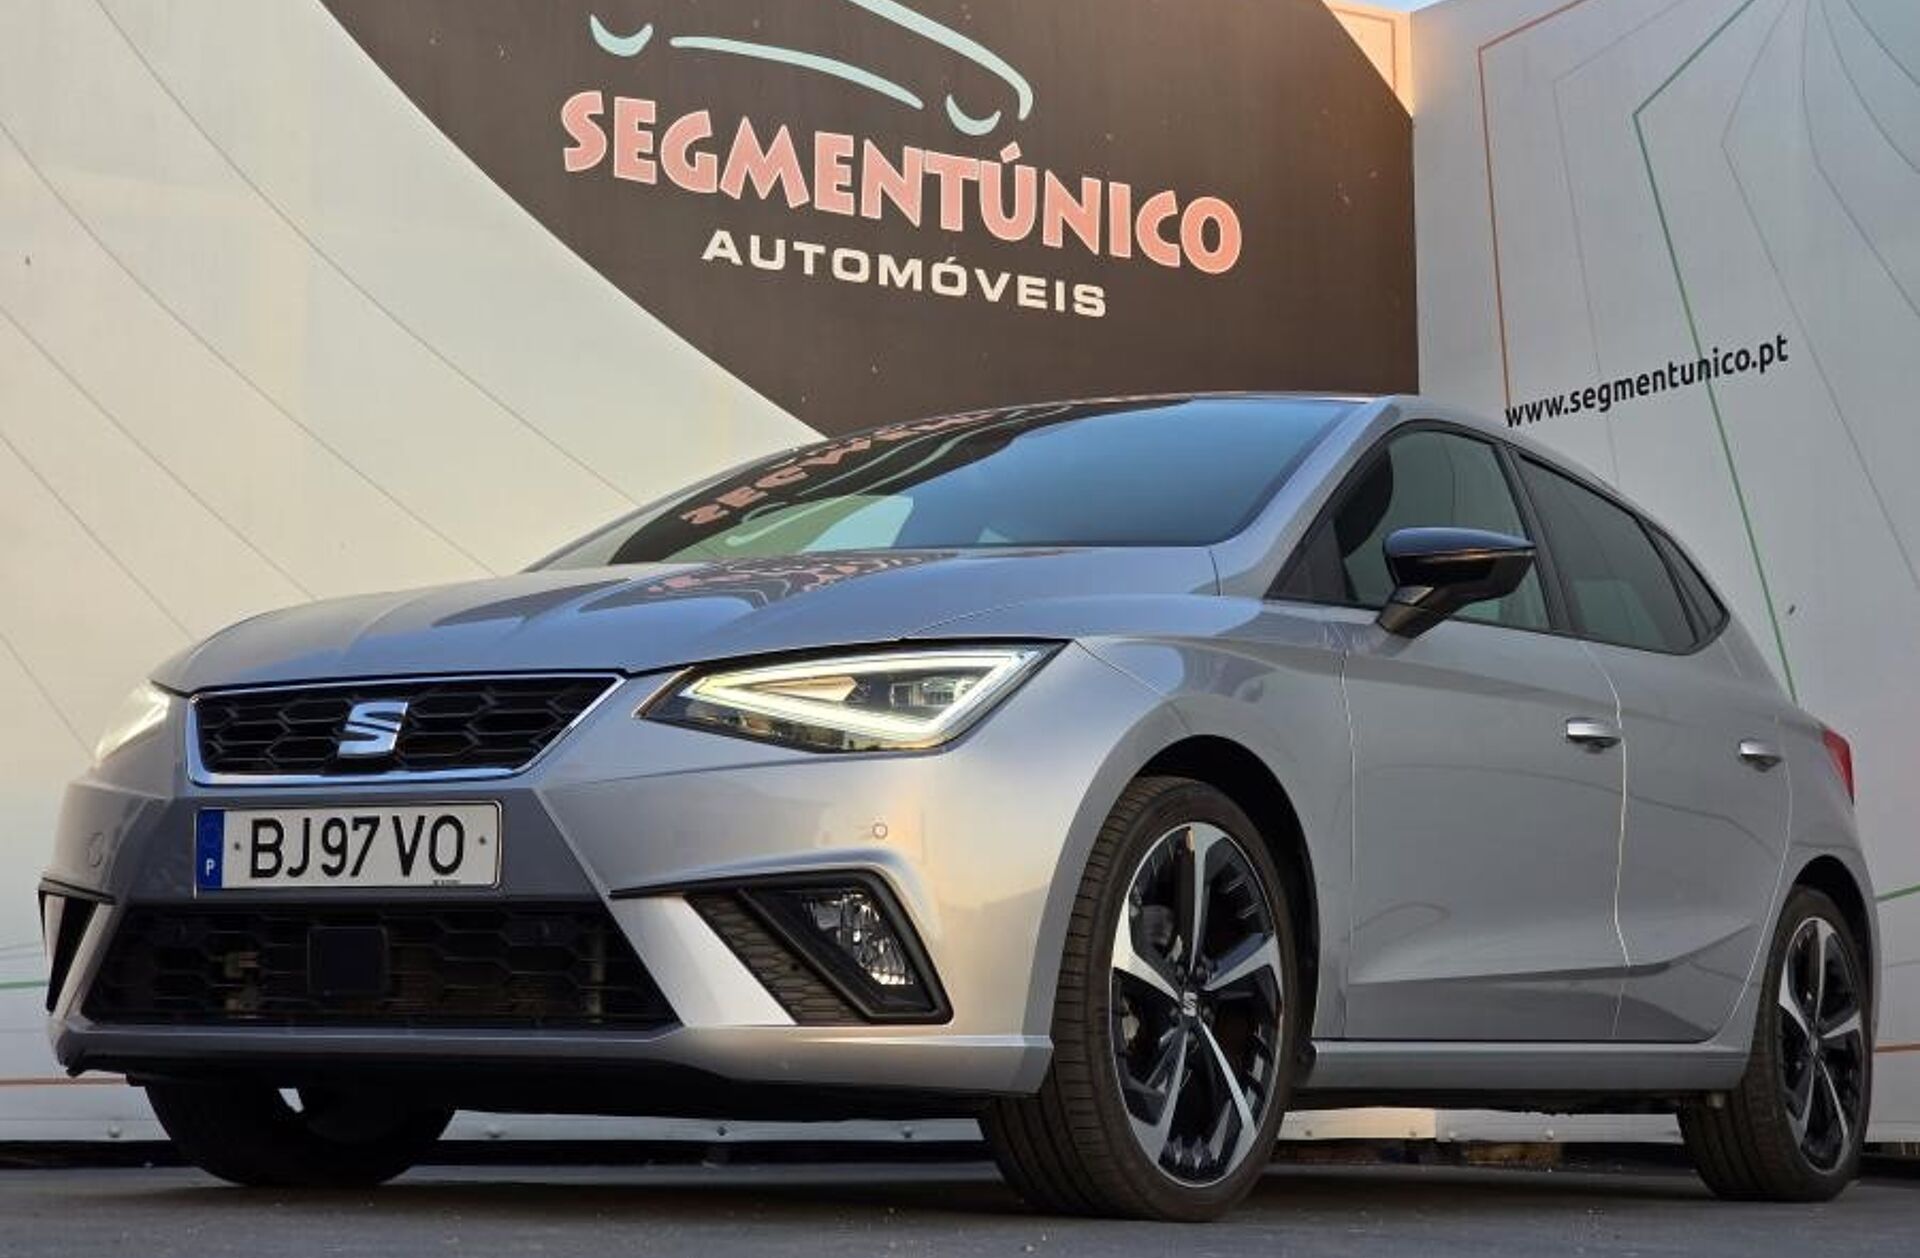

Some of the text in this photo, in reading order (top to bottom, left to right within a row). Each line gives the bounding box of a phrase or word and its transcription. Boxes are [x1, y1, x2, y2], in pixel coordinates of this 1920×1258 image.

[561, 91, 1242, 275] SEGMENTÚNICO
[701, 230, 1107, 318] AUTOMÓVEIS
[1505, 335, 1789, 427] www.segmentunico.pt
[205, 858, 215, 877] P
[392, 814, 465, 878] VO
